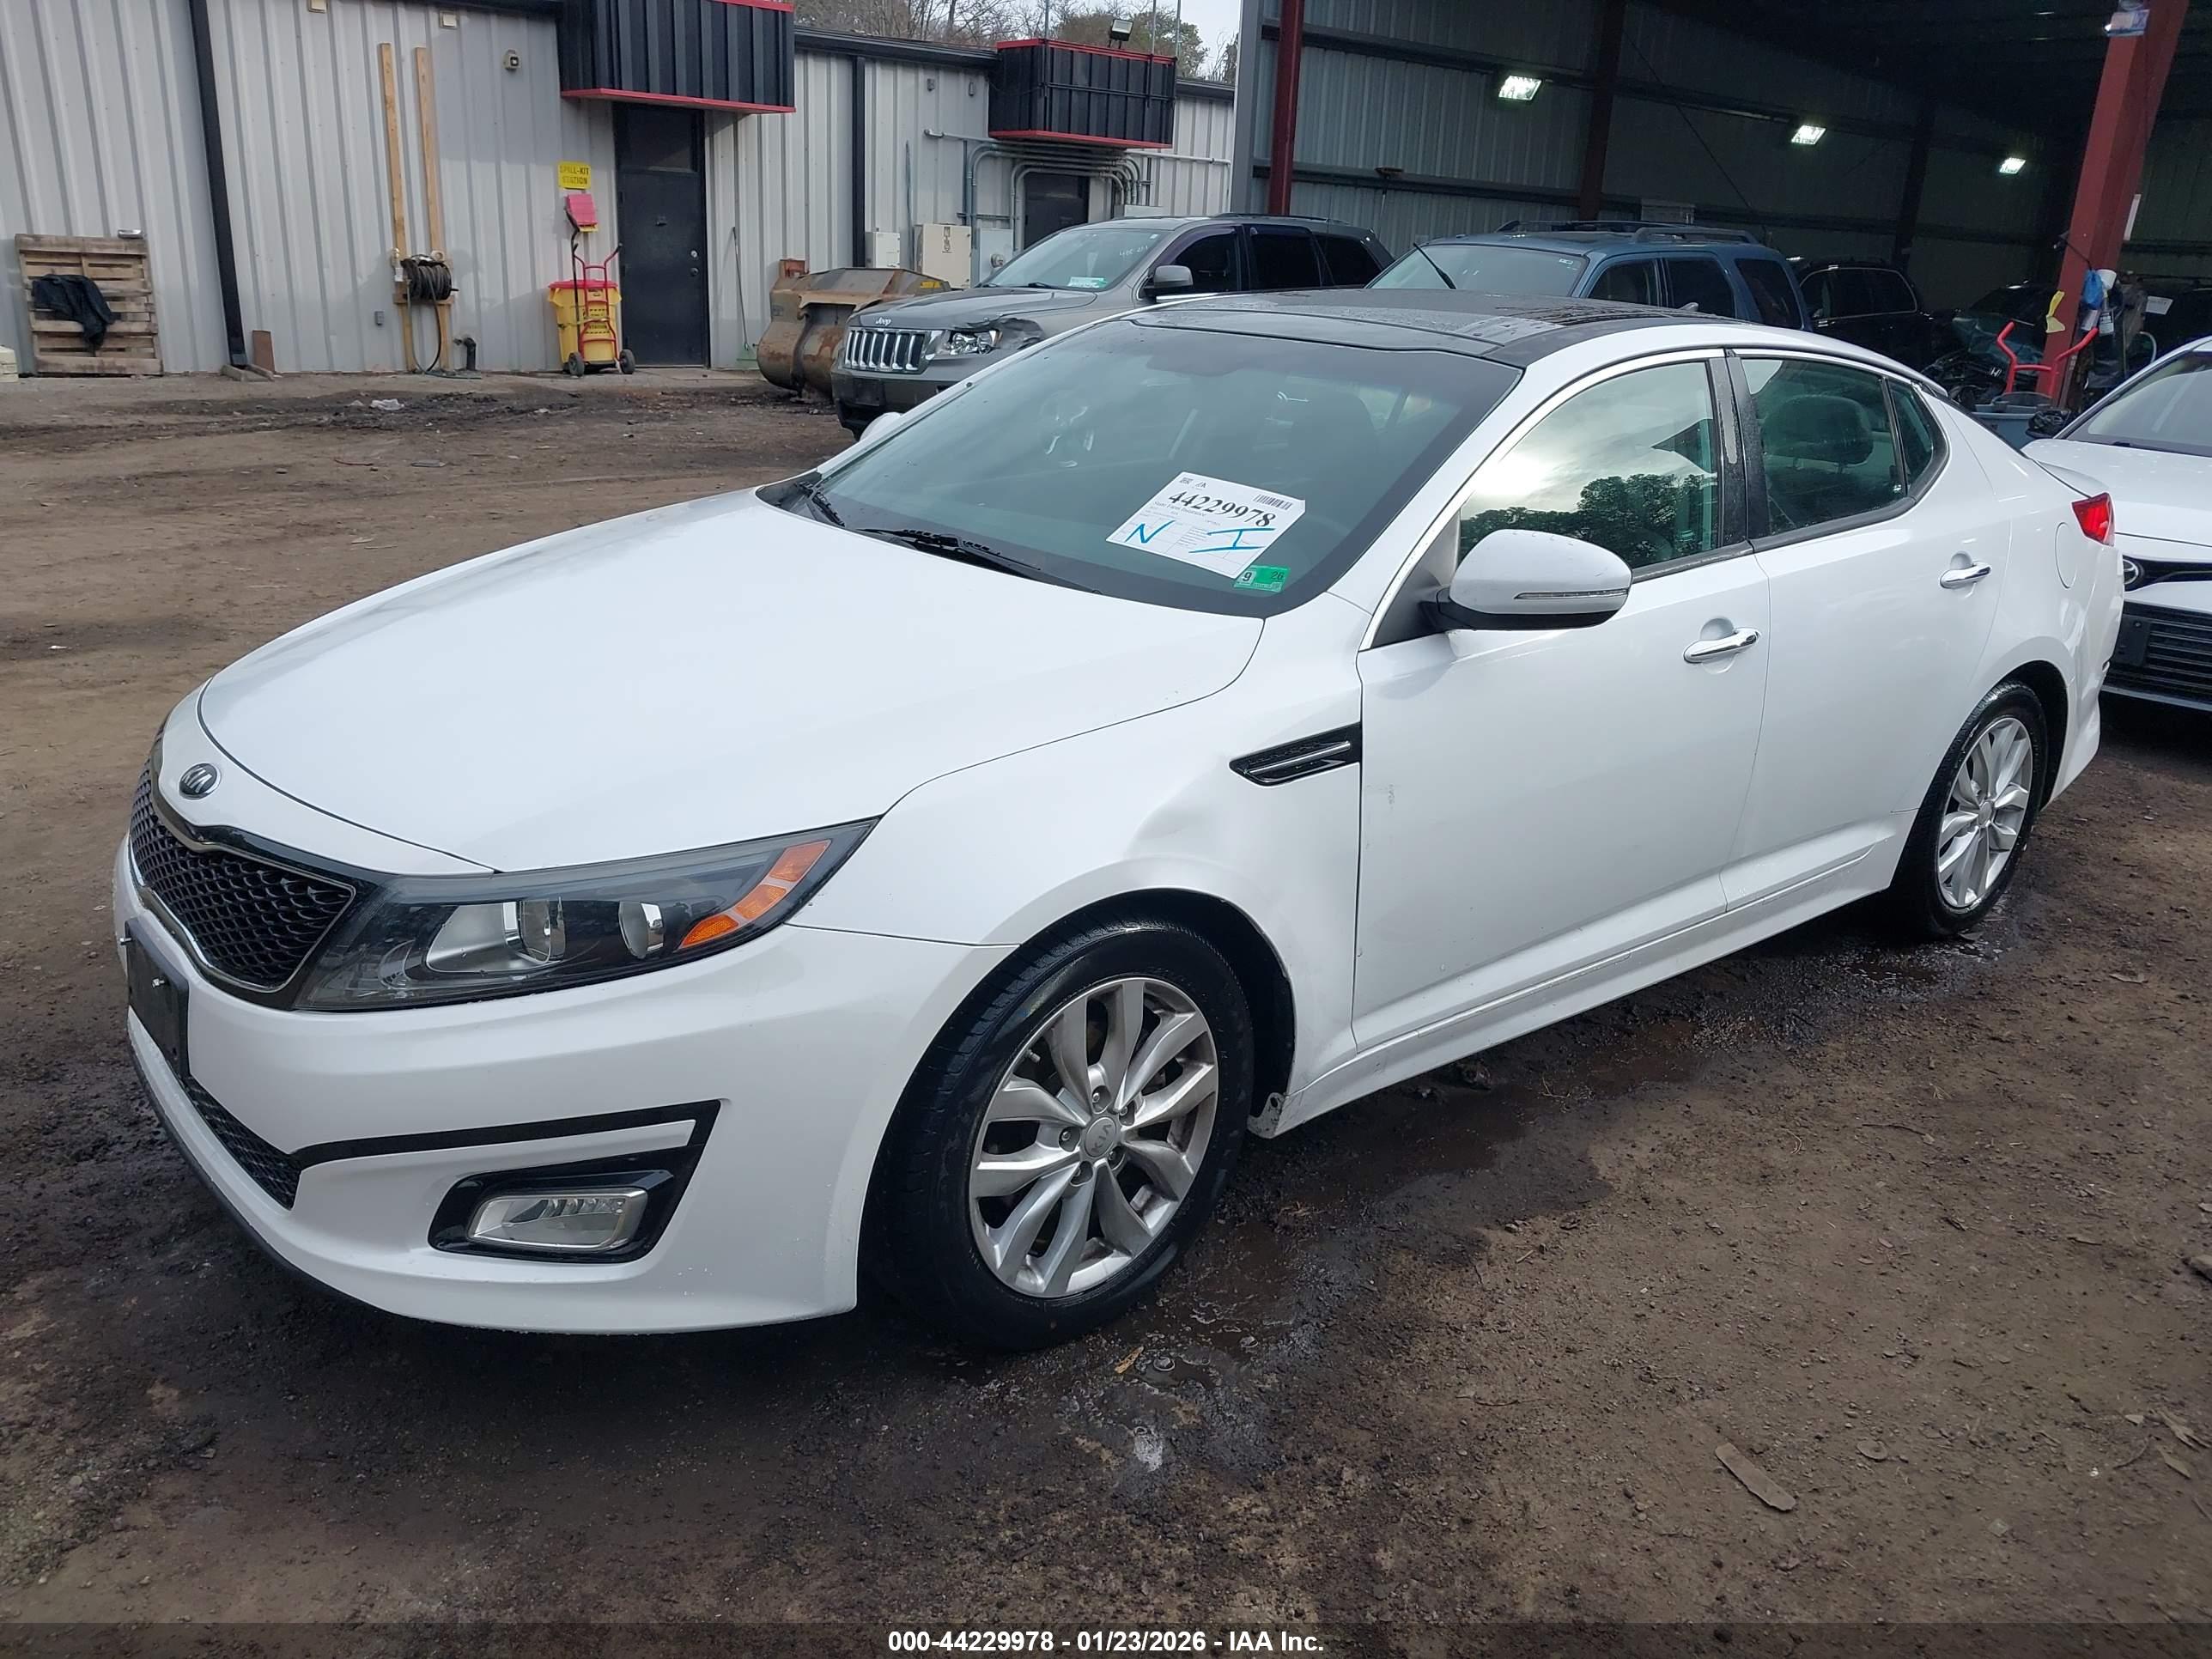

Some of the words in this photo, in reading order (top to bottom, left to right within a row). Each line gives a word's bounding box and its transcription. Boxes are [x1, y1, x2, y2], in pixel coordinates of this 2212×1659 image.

[1169, 490, 1276, 526] 44229978
[1124, 520, 1176, 543] N
[1243, 571, 1252, 581] 9
[1271, 570, 1285, 580] 26
